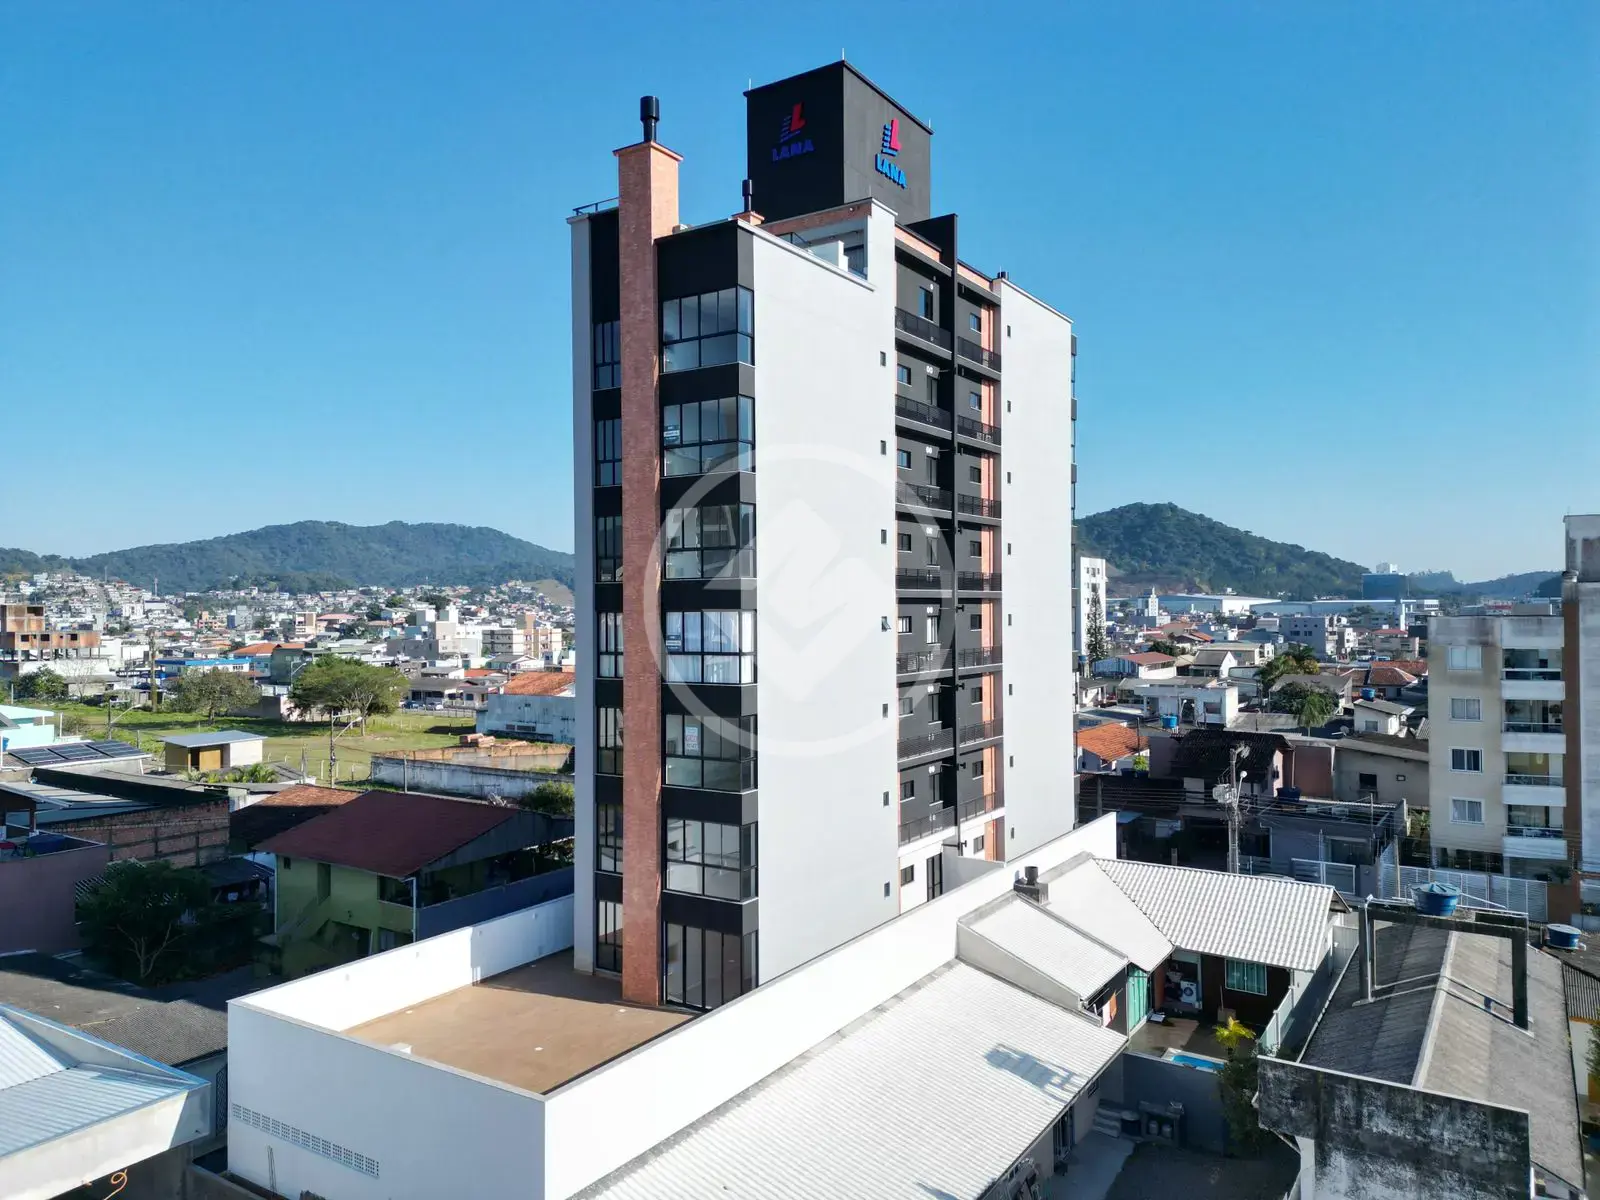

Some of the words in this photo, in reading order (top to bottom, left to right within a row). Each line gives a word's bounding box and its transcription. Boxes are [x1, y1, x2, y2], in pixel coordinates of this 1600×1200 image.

[790, 102, 806, 132] L
[890, 118, 902, 151] L
[772, 139, 815, 162] LANA
[875, 153, 907, 189] LANA
